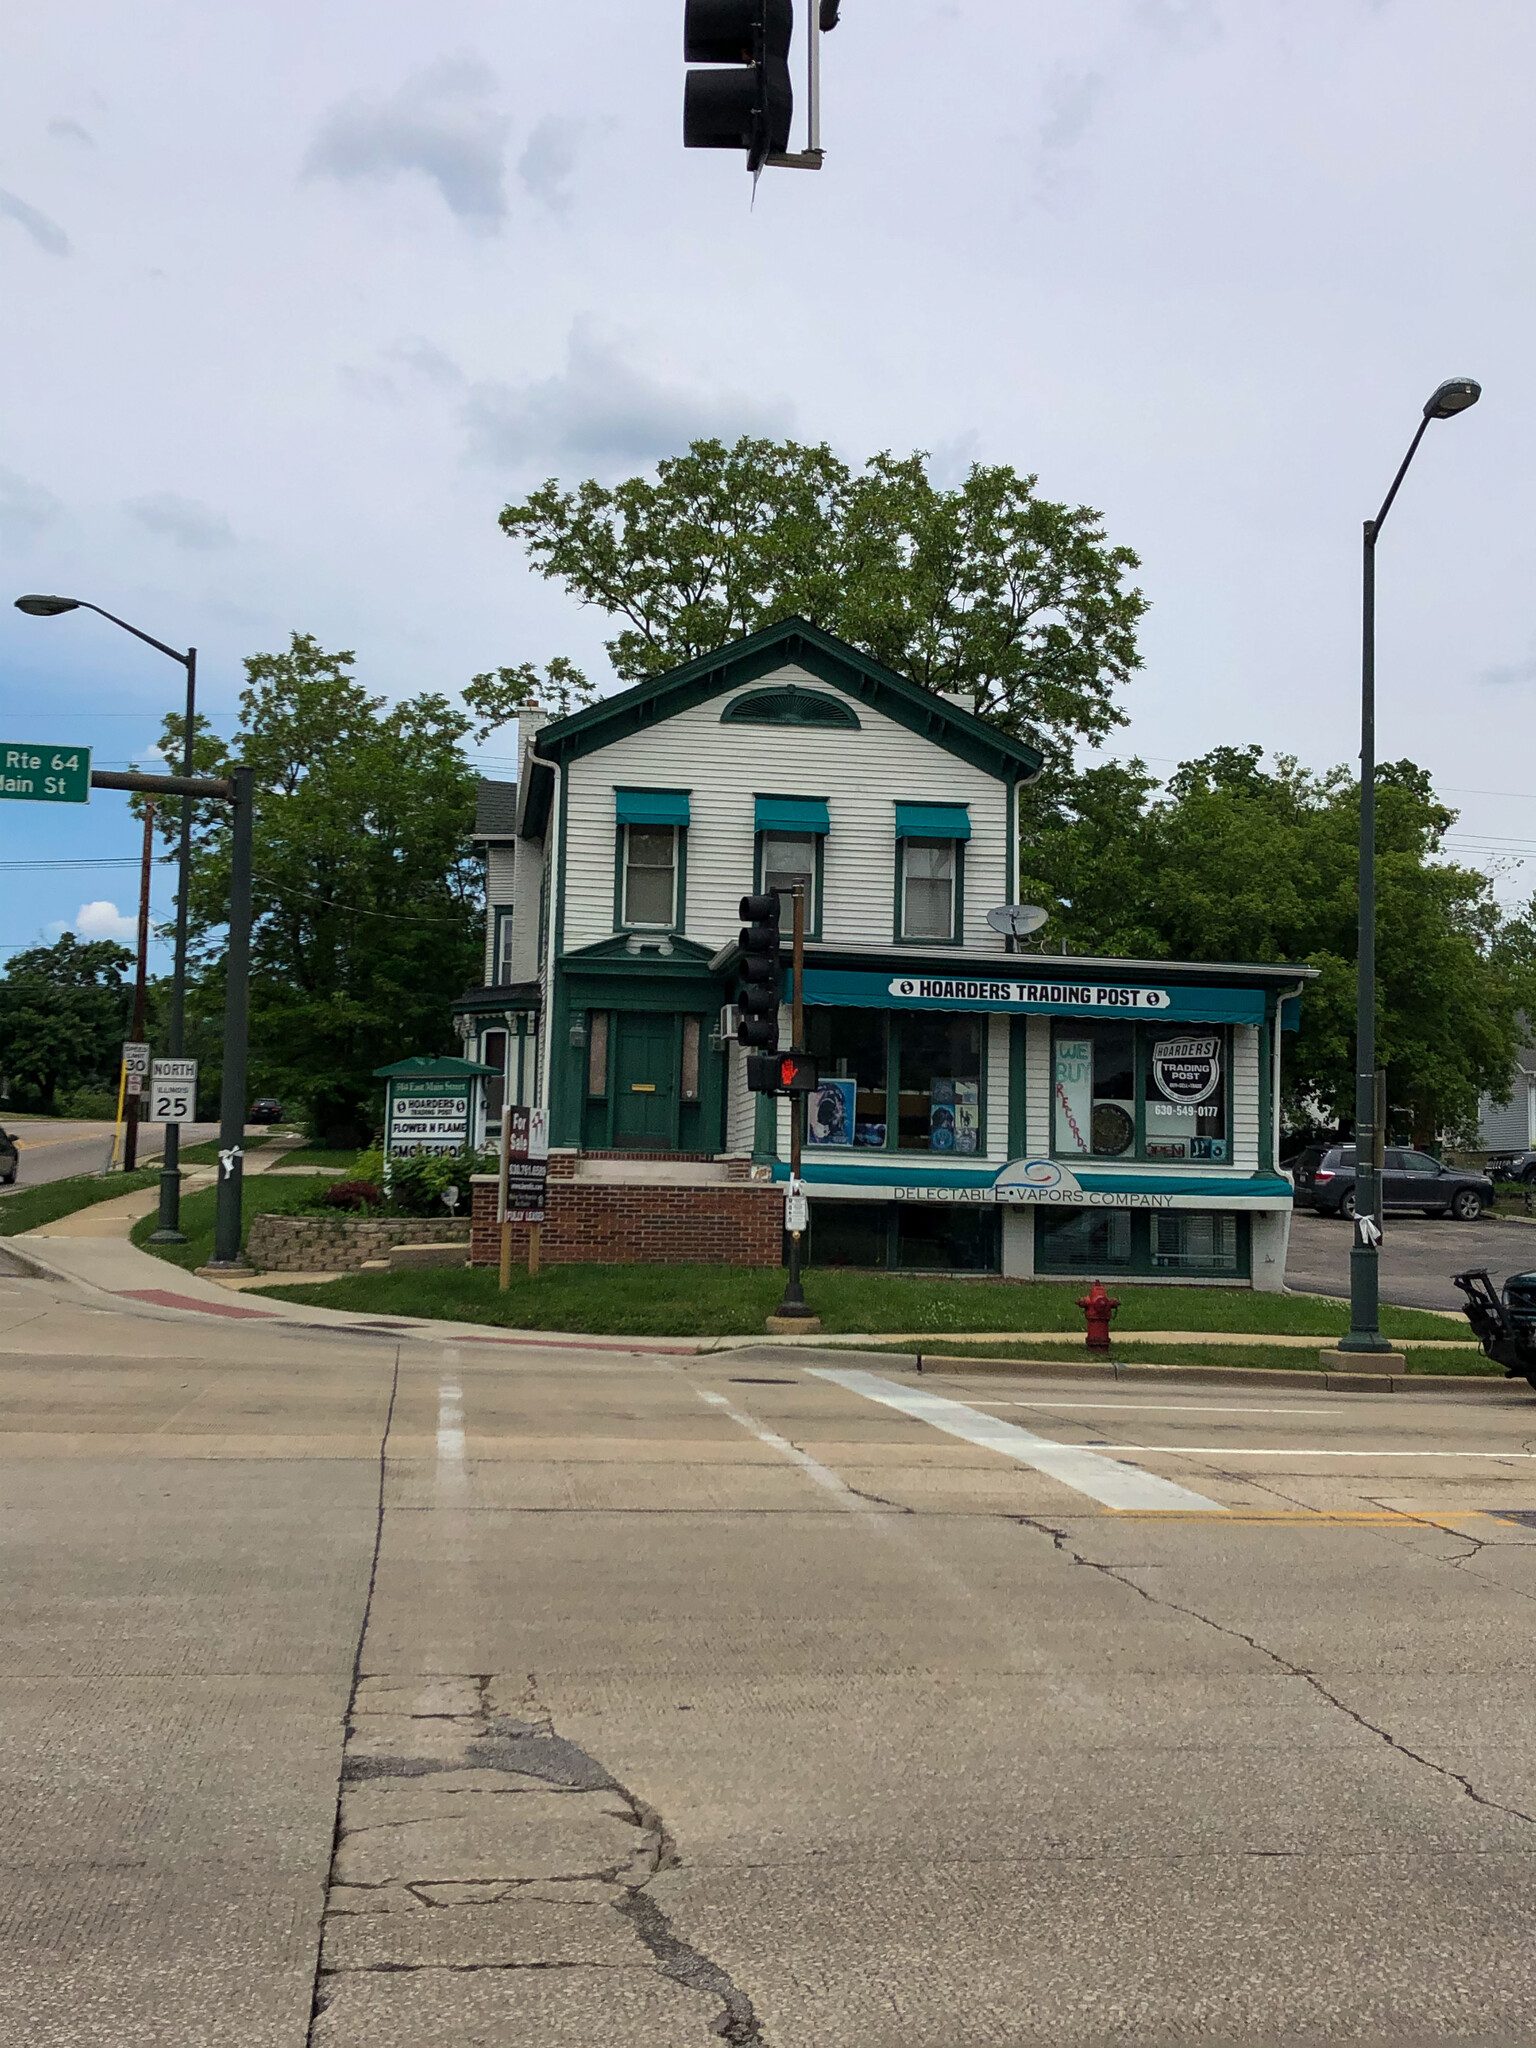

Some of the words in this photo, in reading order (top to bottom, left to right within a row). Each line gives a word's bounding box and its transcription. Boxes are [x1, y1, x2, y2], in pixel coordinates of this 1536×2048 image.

[6, 750, 42, 770] Rte
[51, 754, 79, 772] 64
[44, 776, 66, 795] St
[919, 980, 1011, 1001] HOARDERS
[1016, 984, 1091, 1004] TRADING
[1097, 988, 1140, 1006] POST
[1060, 1043, 1088, 1060] WE
[1157, 1042, 1212, 1057] HOARDERS
[126, 1060, 145, 1071] 30
[154, 1064, 194, 1075] NORTH
[1056, 1062, 1090, 1083] BUY
[1163, 1064, 1210, 1073] TRADING
[1171, 1072, 1200, 1080] POST
[157, 1097, 187, 1117] 25
[408, 1100, 454, 1108] HOARDERS
[1154, 1105, 1218, 1117] 630-549-0177
[513, 1113, 526, 1130] For
[1056, 1083, 1088, 1154] RECORDS
[393, 1123, 427, 1132] FLOWER
[429, 1123, 436, 1132] N
[438, 1123, 466, 1132] FLAME
[510, 1133, 527, 1151] Sale
[1089, 1192, 1174, 1207] COMPANY
